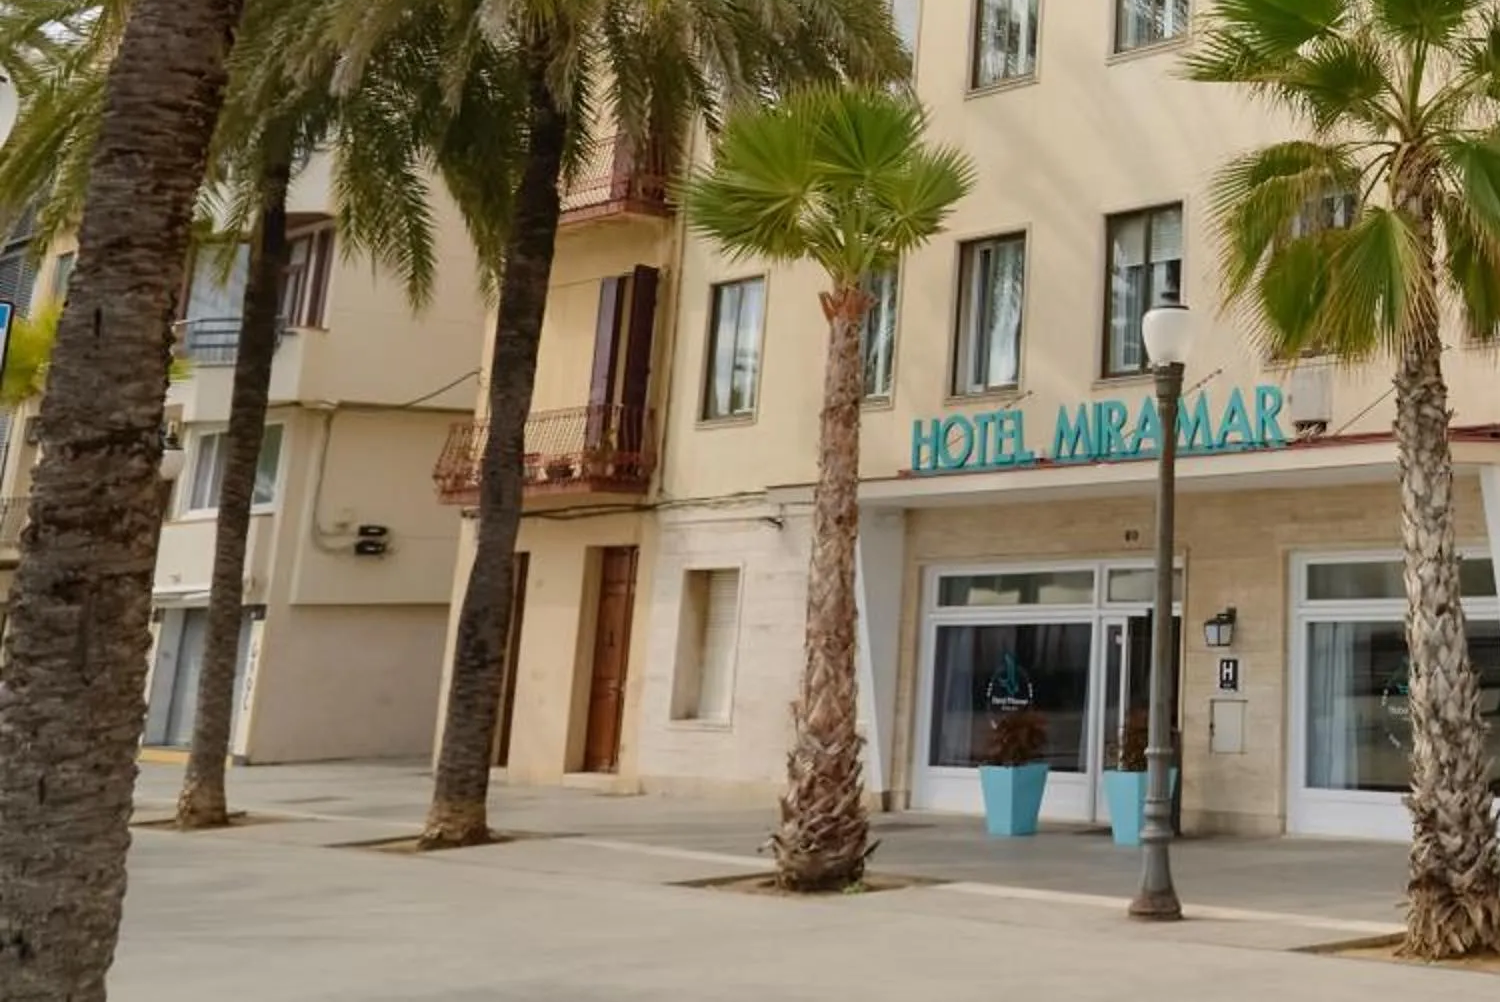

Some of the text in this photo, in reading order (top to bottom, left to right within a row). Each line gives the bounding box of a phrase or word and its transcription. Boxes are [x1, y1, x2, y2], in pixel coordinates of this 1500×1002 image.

[911, 385, 1285, 470] HOTEL MIRAMAR
[1223, 661, 1233, 681] H
